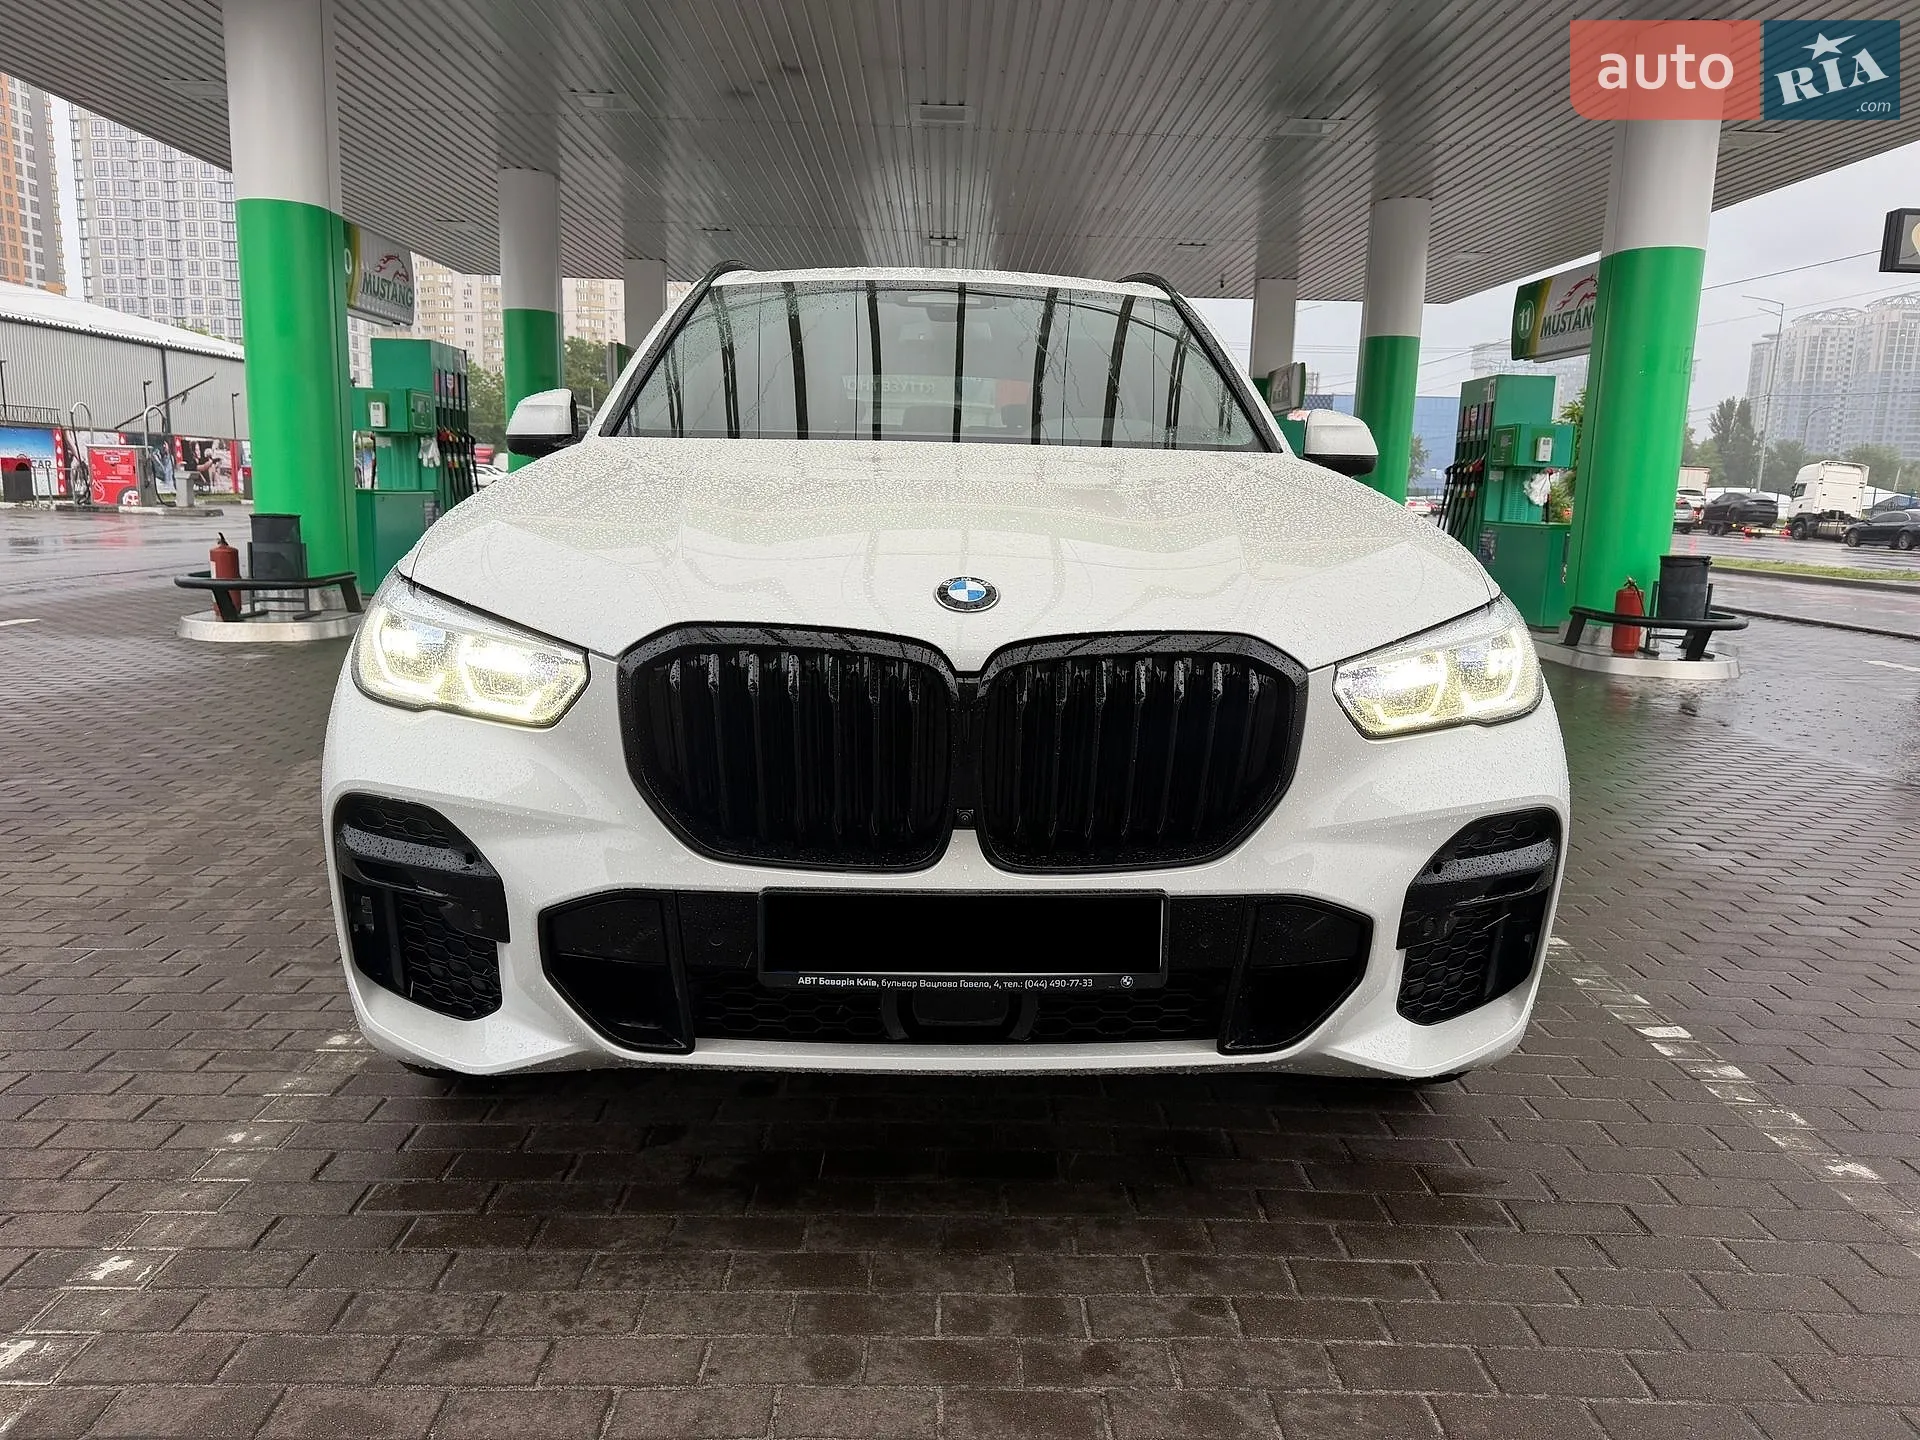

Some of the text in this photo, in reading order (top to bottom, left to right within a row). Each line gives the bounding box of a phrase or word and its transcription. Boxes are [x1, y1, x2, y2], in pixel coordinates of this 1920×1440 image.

[361, 271, 413, 308] MUSTANG
[1519, 307, 1531, 332] 11
[1540, 304, 1595, 338] MUSTAN
[818, 977, 855, 987] Баварія
[856, 978, 879, 988] Київ,
[881, 979, 918, 988] бульвар
[1025, 979, 1048, 989] (044)
[1049, 978, 1093, 988] 490-77-33
